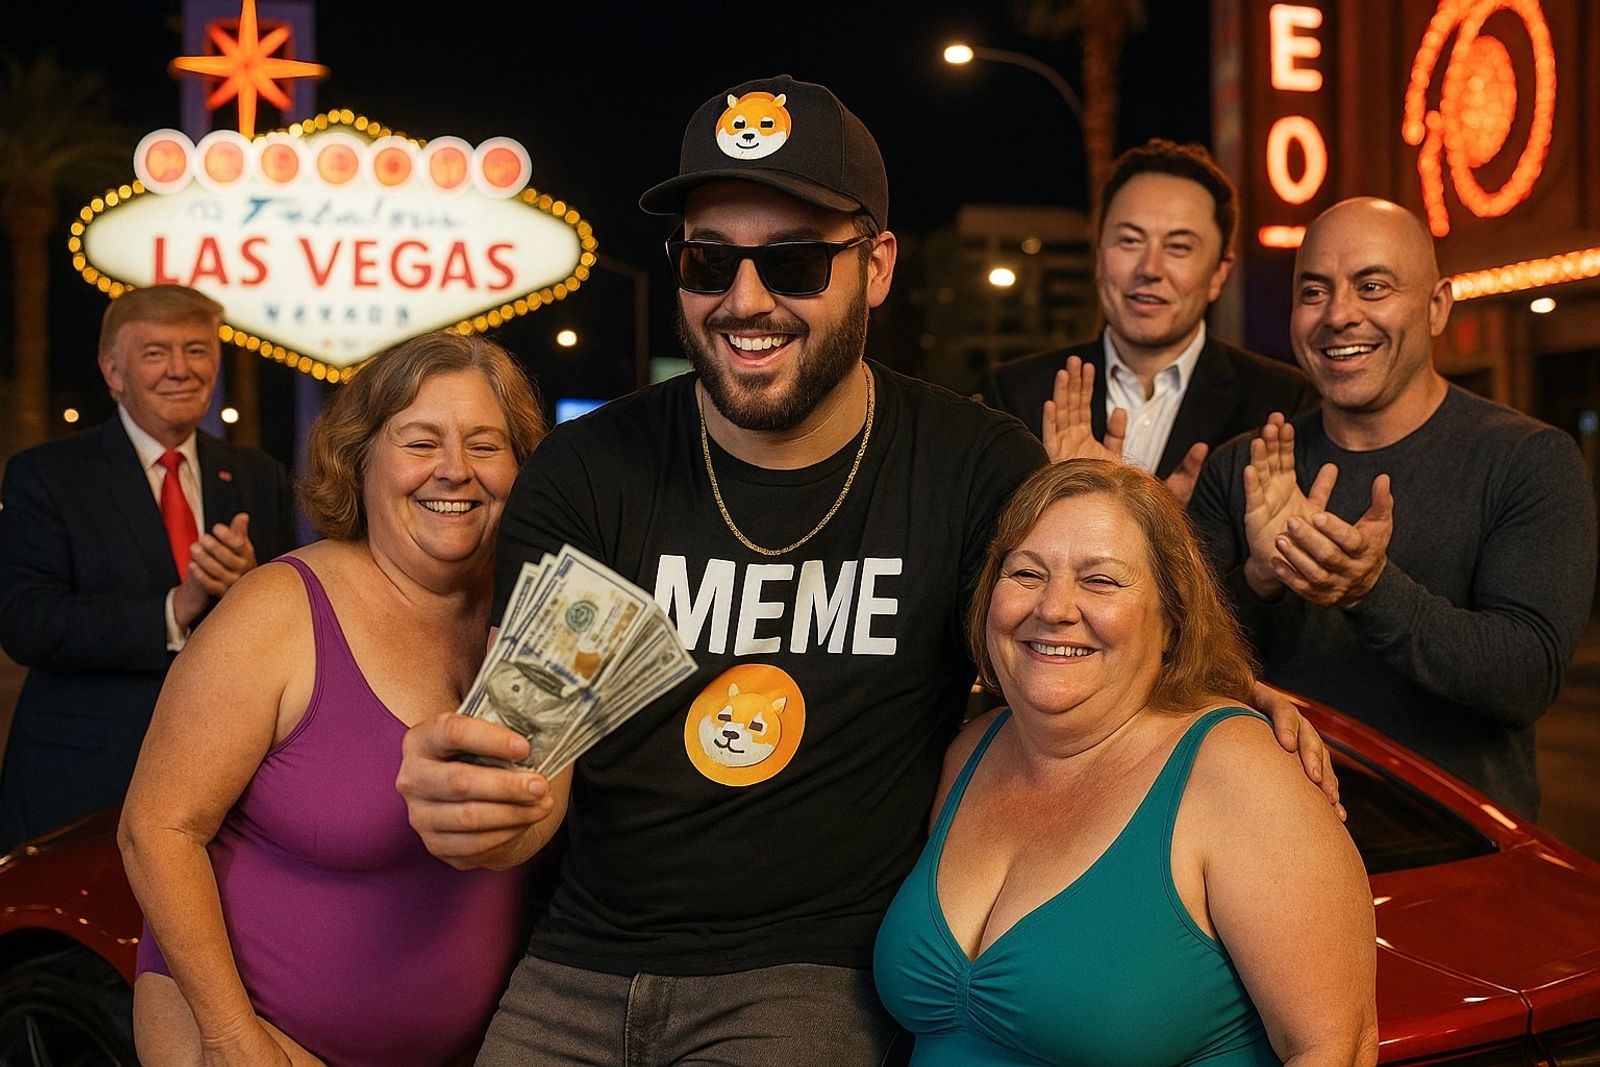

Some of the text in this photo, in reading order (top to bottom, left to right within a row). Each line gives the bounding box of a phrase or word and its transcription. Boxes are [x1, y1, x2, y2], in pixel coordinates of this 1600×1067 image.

[1259, 4, 1328, 249] EO
[153, 236, 515, 292] LAS VEGAS
[655, 554, 903, 656] MEME
